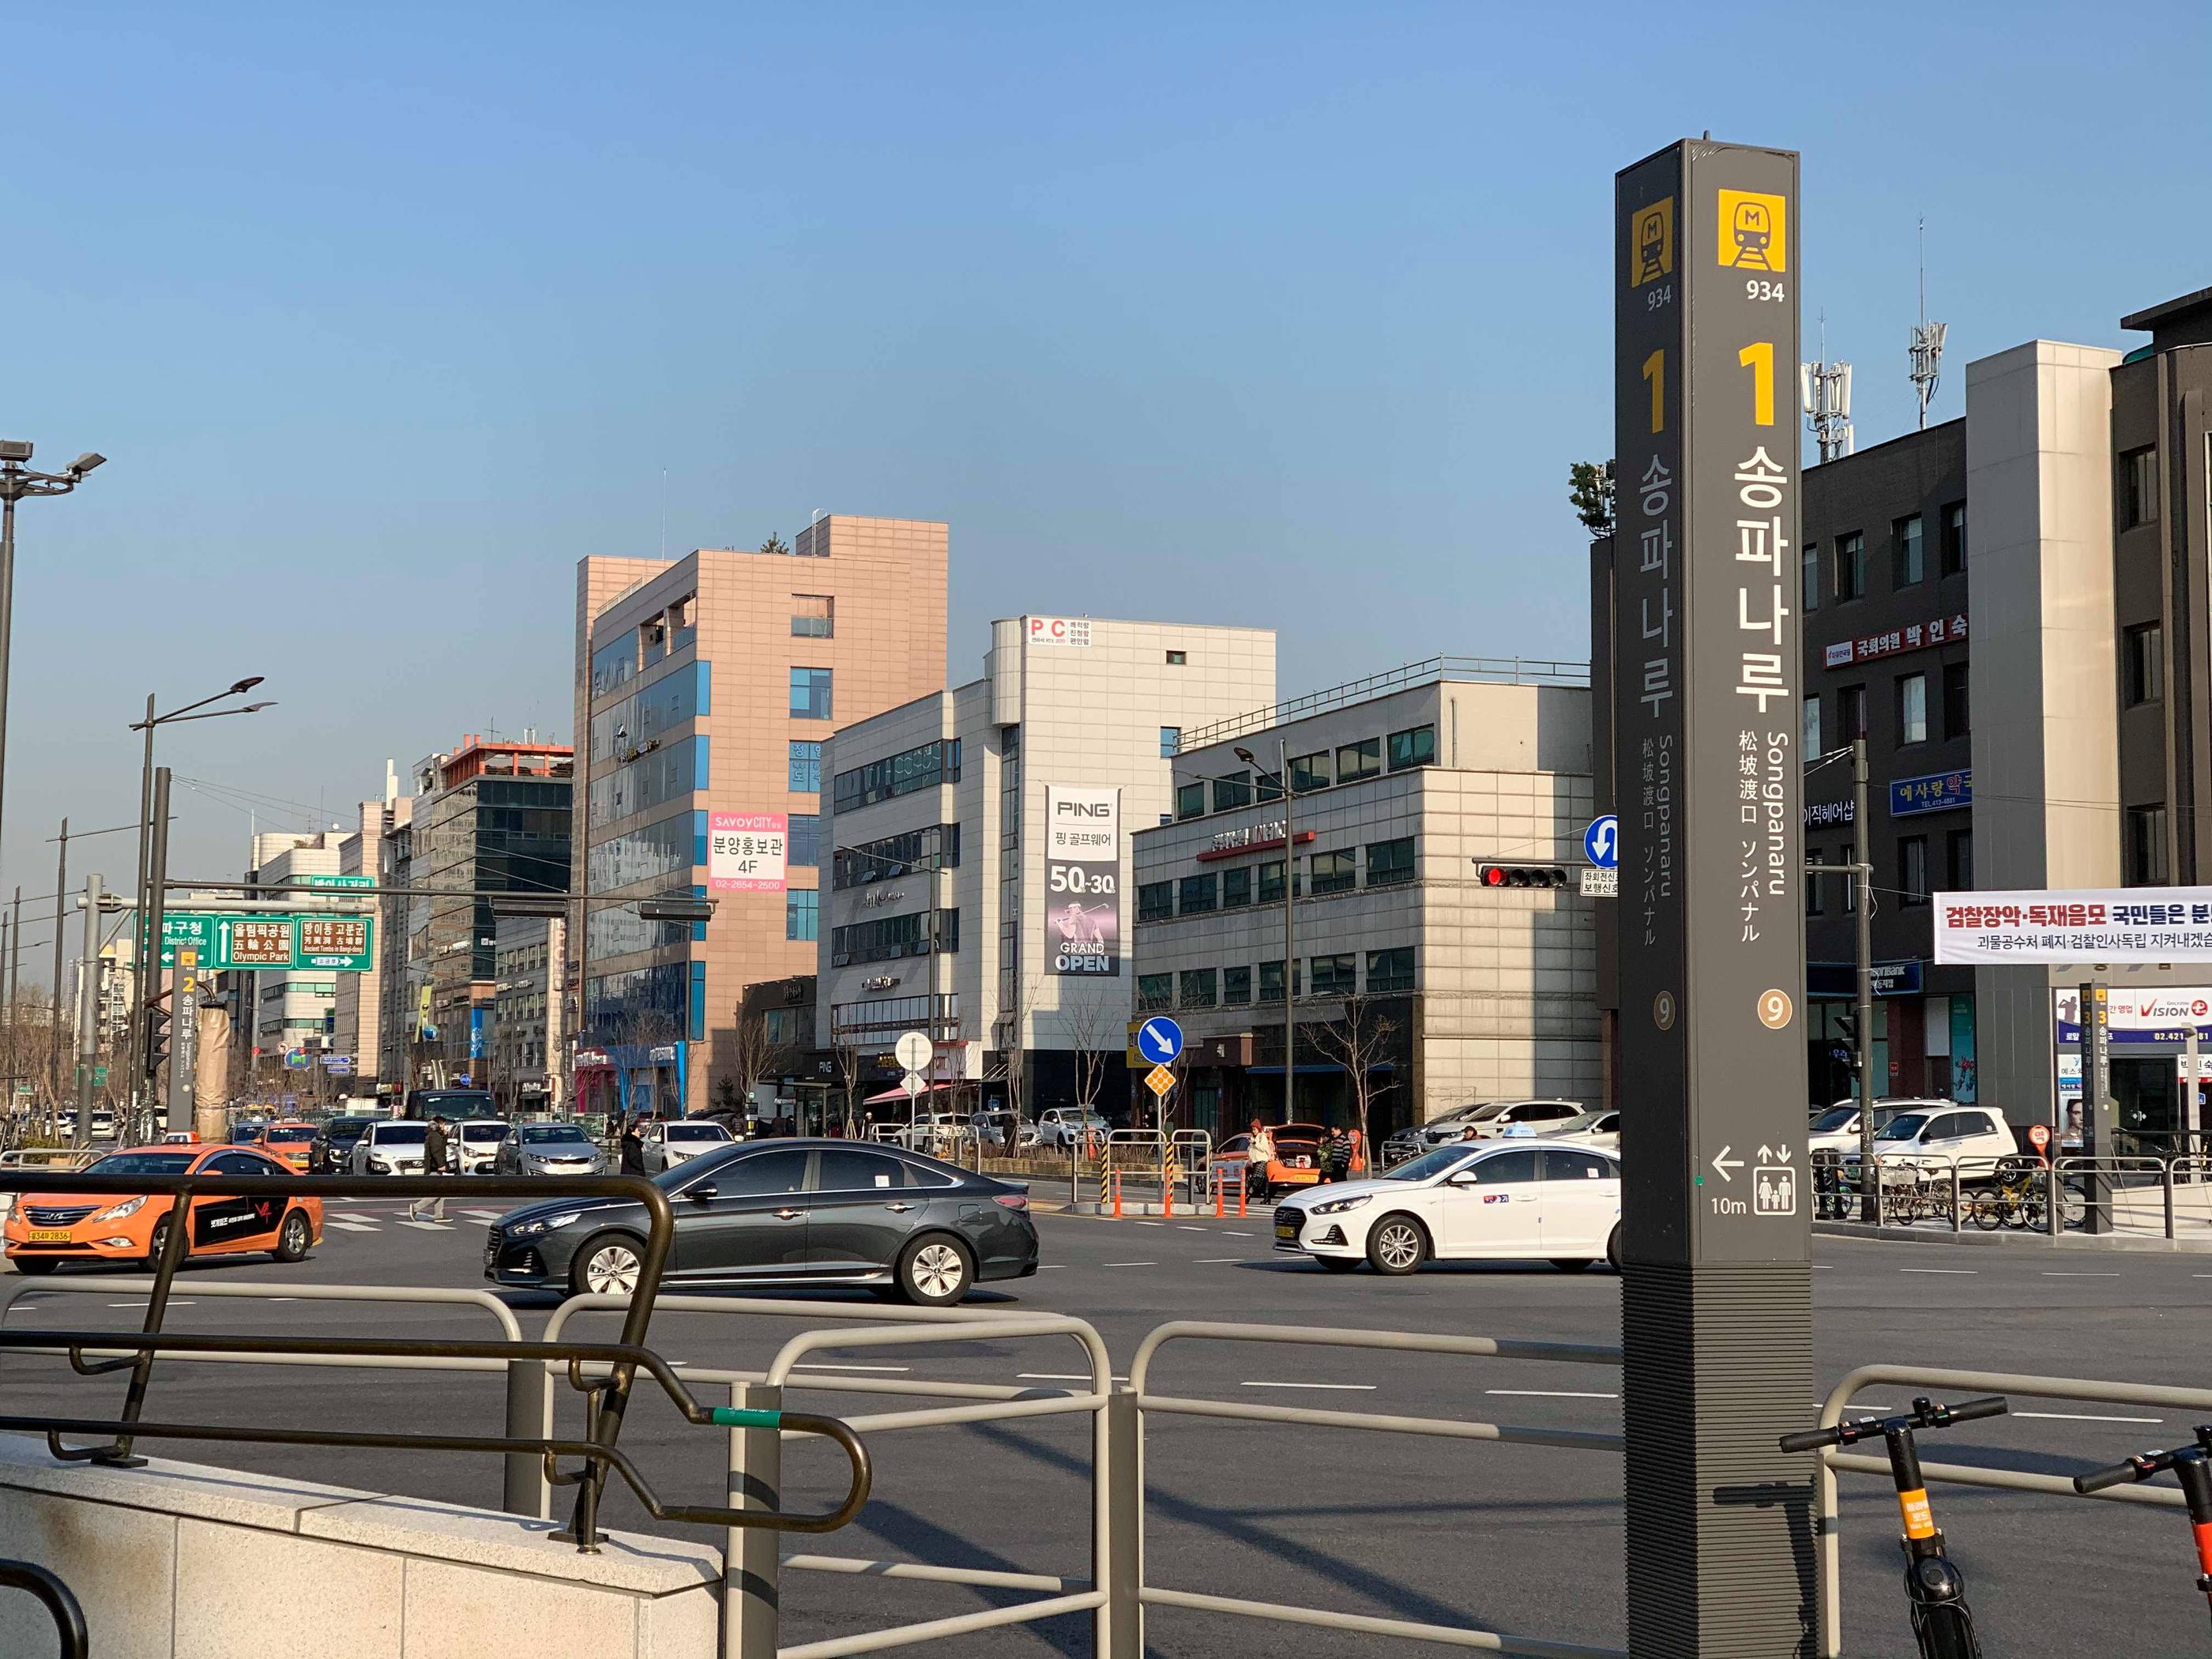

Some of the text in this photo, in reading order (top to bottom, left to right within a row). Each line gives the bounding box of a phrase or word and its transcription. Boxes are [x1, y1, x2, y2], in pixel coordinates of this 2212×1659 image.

[1647, 285, 1672, 311] 934
[1746, 279, 1785, 303] 934
[1642, 348, 1664, 434] 1
[1738, 341, 1774, 426] 1
[1639, 453, 1673, 718] 송파나루
[1734, 446, 1789, 713] 송파나루
[1857, 631, 1901, 656] 국회의원
[1057, 801, 1109, 817] PING
[1657, 735, 1673, 898] Songpanaru
[1762, 731, 1789, 896] Songpanaru
[1055, 832, 1111, 846] 핑 골프웨어
[1738, 730, 1760, 943] 松坡渡口 ソンパナル
[713, 836, 783, 856] 분양홍보관
[738, 860, 758, 874] 4F
[1585, 871, 1618, 882] 좌회전신
[1584, 883, 1618, 893] 보행신호
[2112, 904, 2185, 926] 국민들은
[2191, 904, 2212, 924] 분
[145, 921, 202, 935] 파구청
[234, 924, 290, 939] 올림픽공원
[304, 923, 364, 936] 방이동 고분군
[164, 936, 207, 946] District Office
[1060, 942, 1104, 954] GRAND
[1977, 935, 2037, 950] 괴물공수처
[233, 951, 289, 962] Olympic Park
[1055, 954, 1109, 972] OPEN
[182, 976, 195, 992] 2
[1767, 996, 1783, 1022] 9
[2118, 1005, 2133, 1014] 영업
[2141, 998, 2189, 1017] VISION
[181, 995, 194, 1040] 송파나루
[2084, 1011, 2091, 1025] 3
[2098, 1010, 2107, 1025] 3
[2098, 1026, 2109, 1066] 송파나루
[1711, 1197, 1747, 1215] 10m
[51, 1232, 68, 1240] 2836
